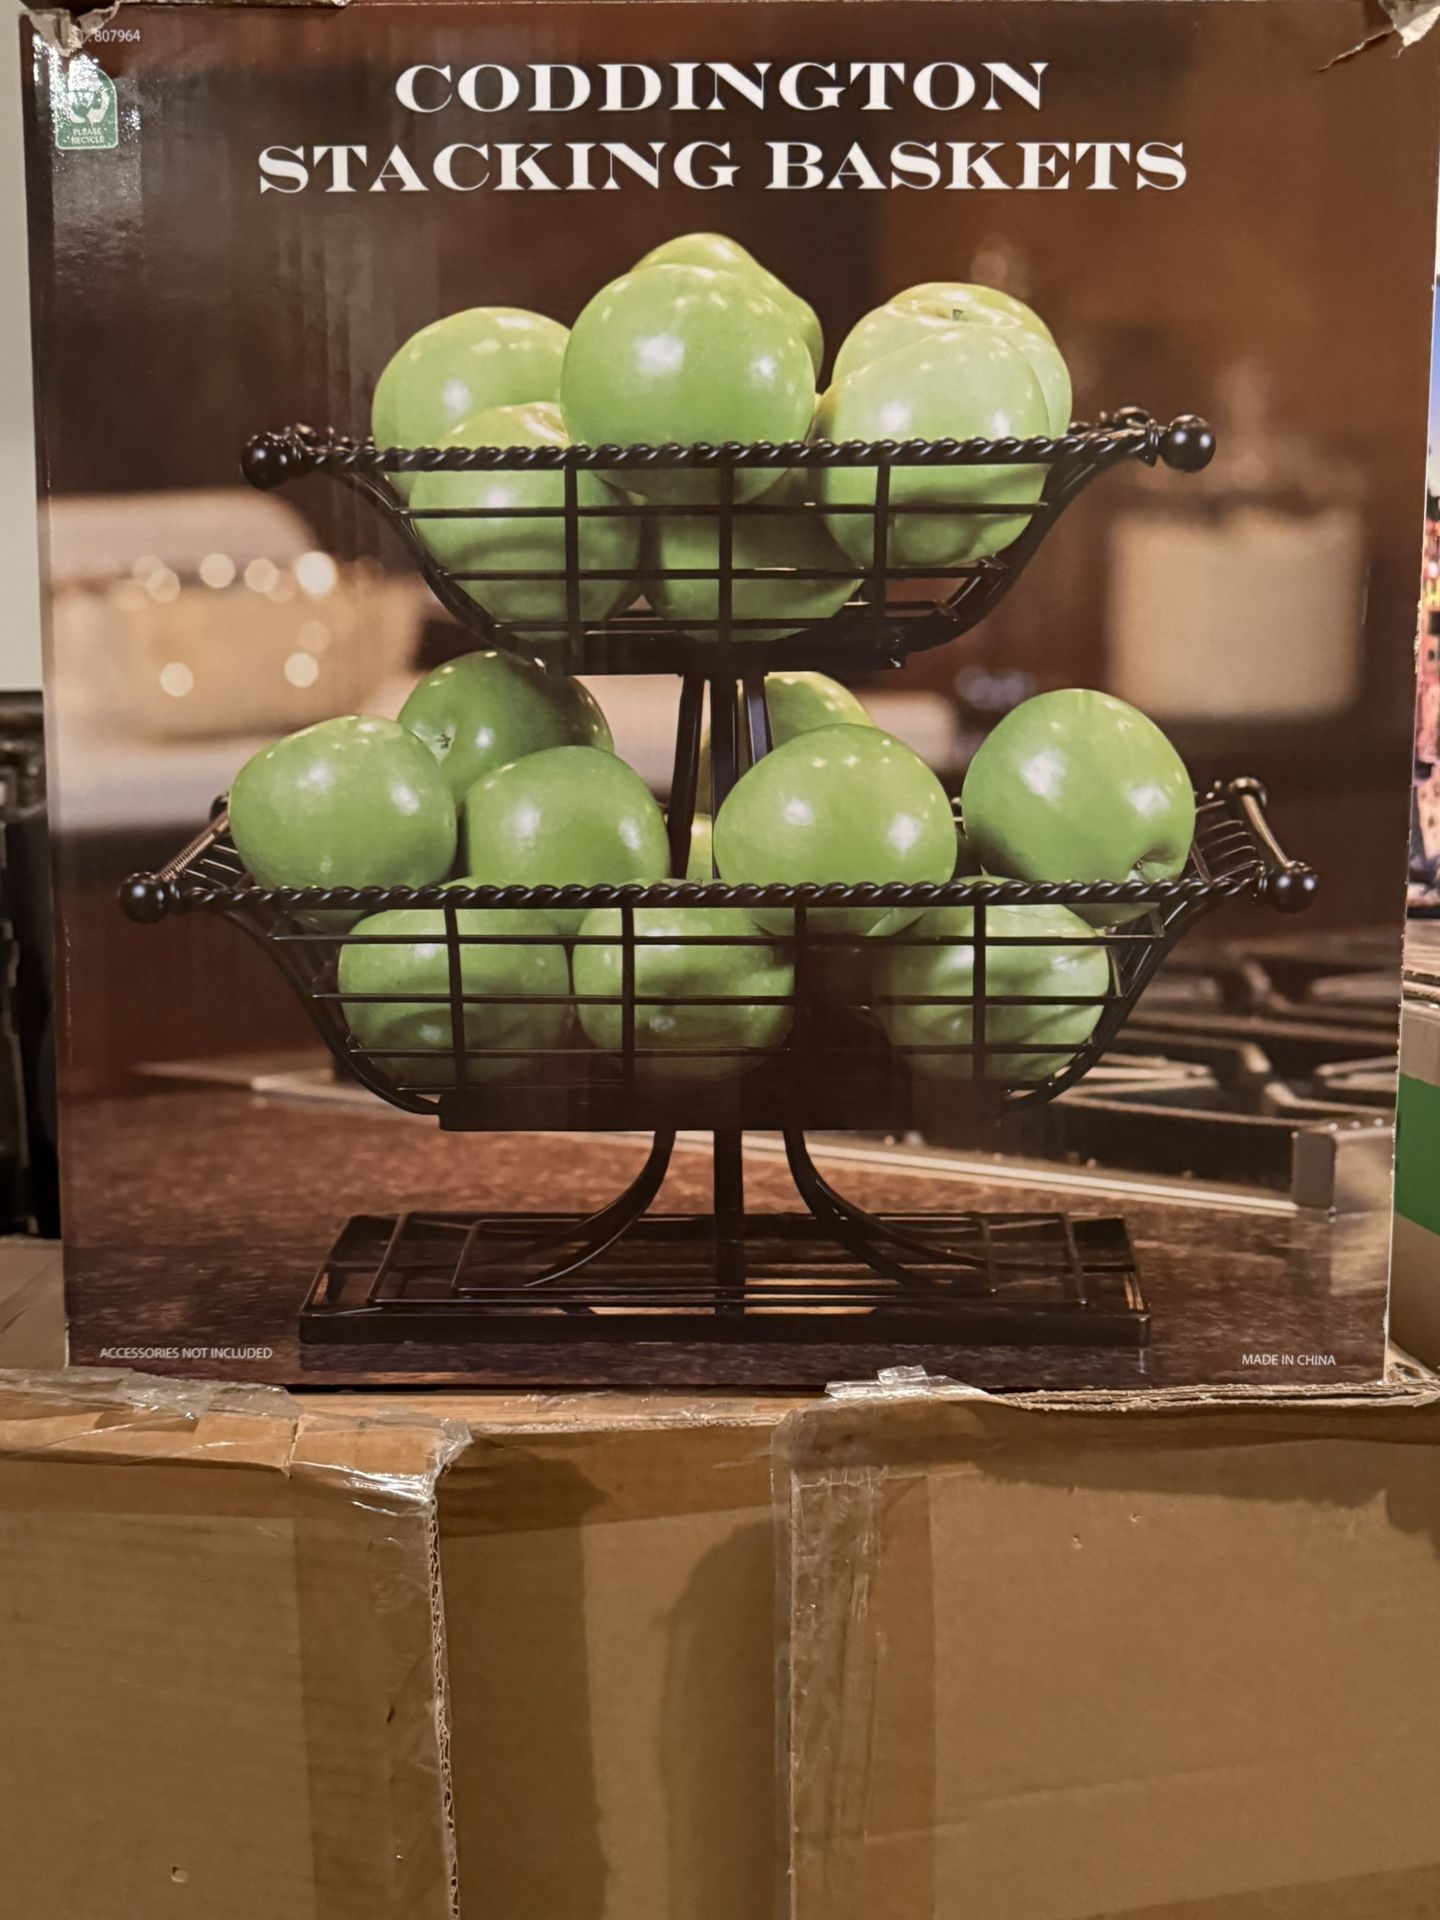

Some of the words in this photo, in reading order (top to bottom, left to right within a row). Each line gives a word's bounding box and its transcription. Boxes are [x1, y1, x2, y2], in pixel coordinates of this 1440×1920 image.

[94, 29, 141, 42] 807964
[395, 62, 1049, 114] CODDINGTON
[258, 141, 740, 194] STACKING
[765, 140, 1188, 192] BASKETS
[100, 1347, 179, 1359] ACCESSORIES
[182, 1347, 208, 1359] NOT
[210, 1347, 273, 1359] INCLUDED
[1241, 1354, 1279, 1366] MADE
[1281, 1354, 1295, 1366] IN
[1296, 1354, 1336, 1366] CHINA
